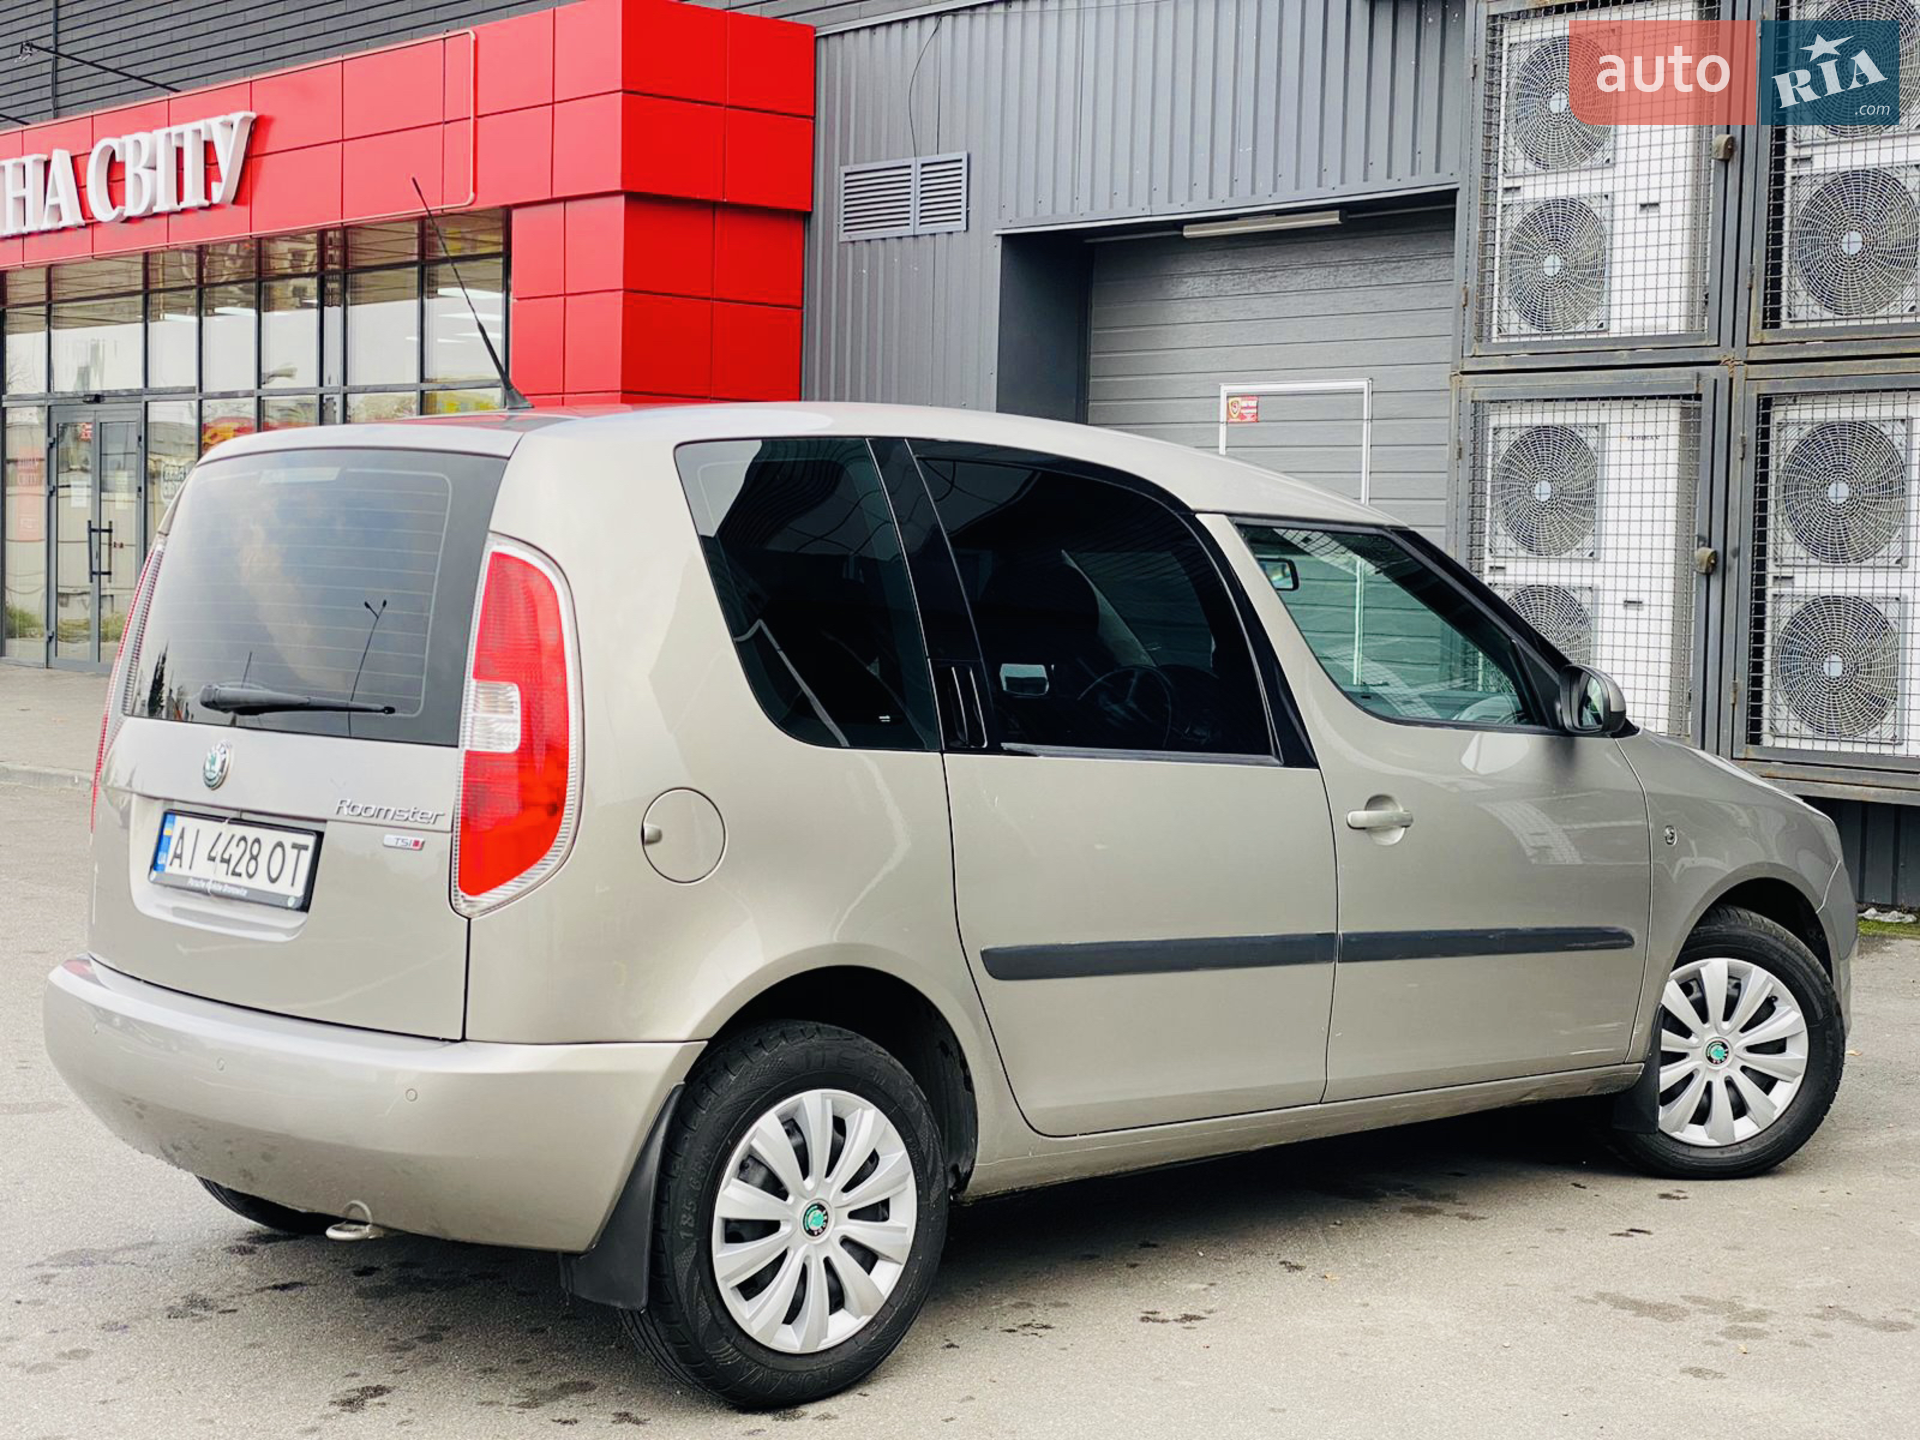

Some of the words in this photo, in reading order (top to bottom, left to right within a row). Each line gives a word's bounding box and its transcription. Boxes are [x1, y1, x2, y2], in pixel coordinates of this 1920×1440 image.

[86, 111, 257, 223] СВІТУ
[336, 799, 446, 825] Roomster
[169, 826, 200, 870] AI
[207, 831, 262, 879] 4428
[267, 840, 310, 887] OT
[394, 836, 413, 847] TSI
